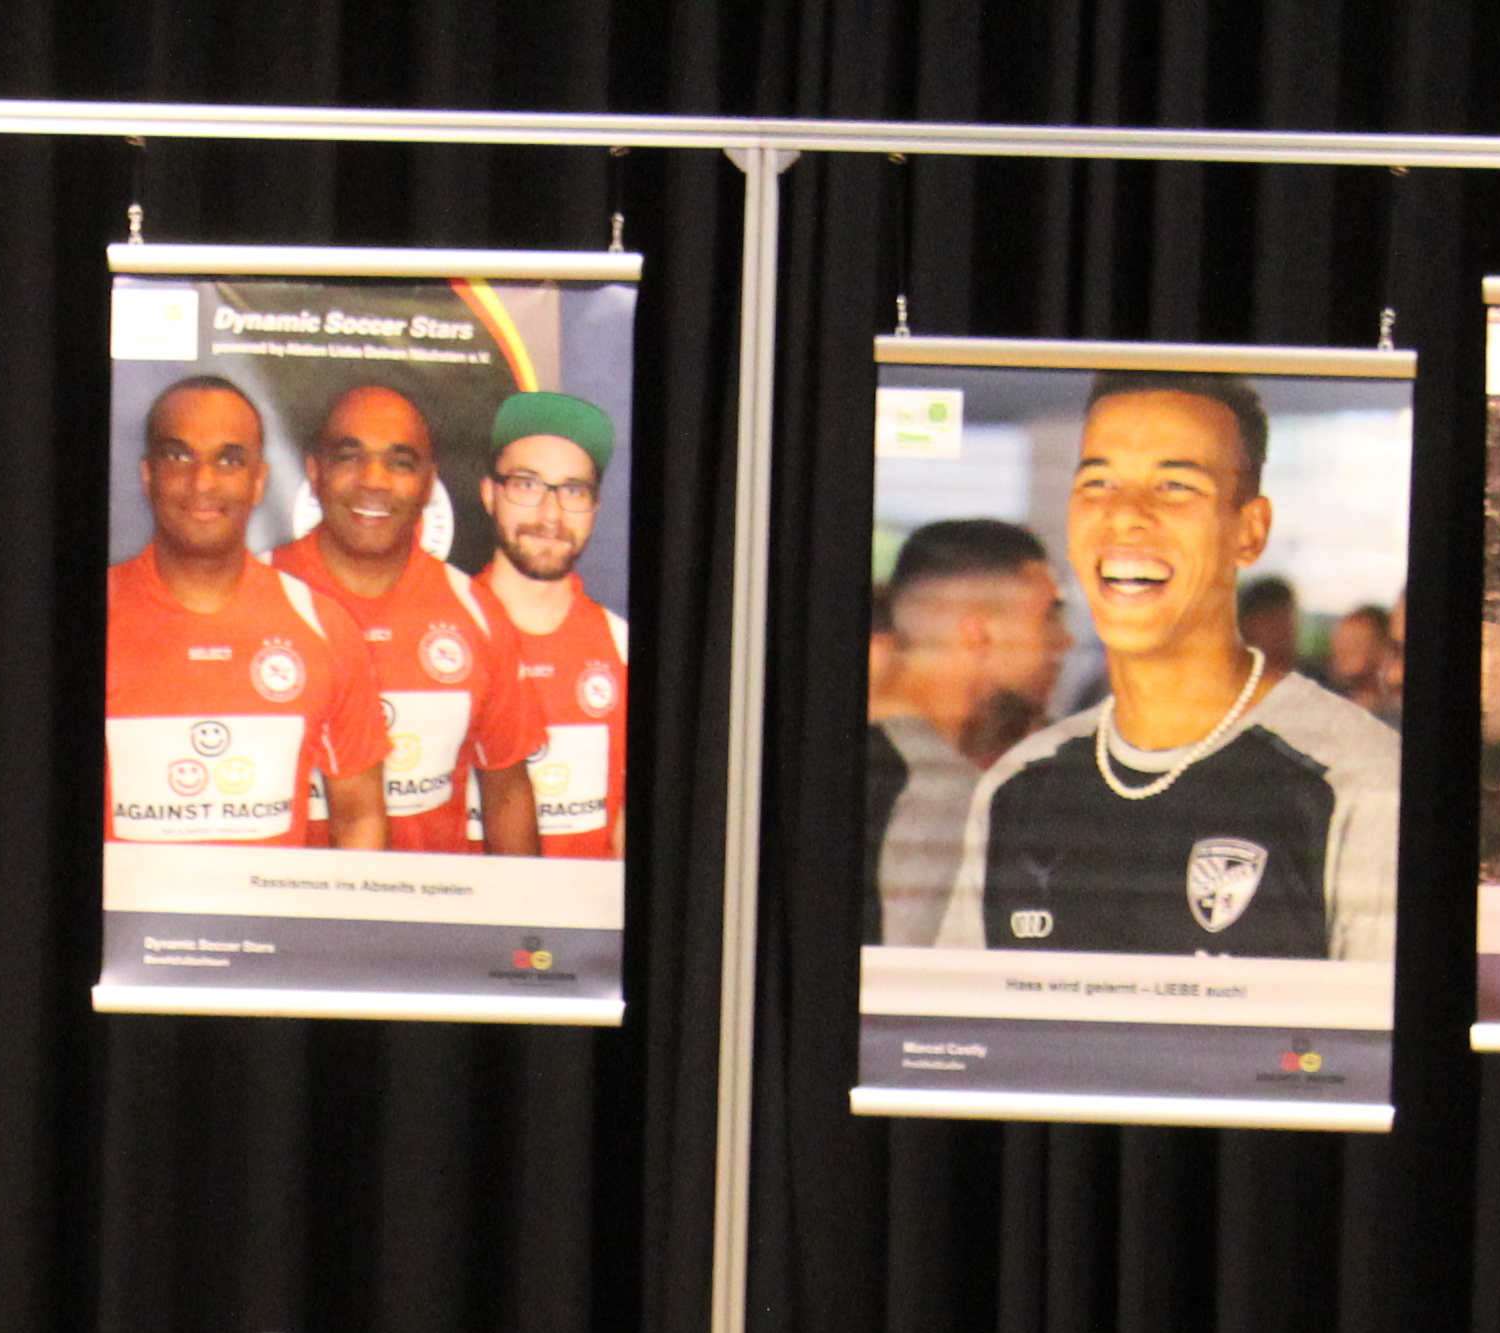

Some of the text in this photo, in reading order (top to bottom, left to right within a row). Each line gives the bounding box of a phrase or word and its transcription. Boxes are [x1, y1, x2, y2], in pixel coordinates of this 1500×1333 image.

[115, 799, 292, 820] AGAINST RACISM
[1005, 978, 1042, 993] Hass
[1049, 979, 1080, 994] wird
[1086, 981, 1137, 997] gelernt
[1154, 982, 1199, 997] LIEBE
[1206, 983, 1246, 999] auch!
